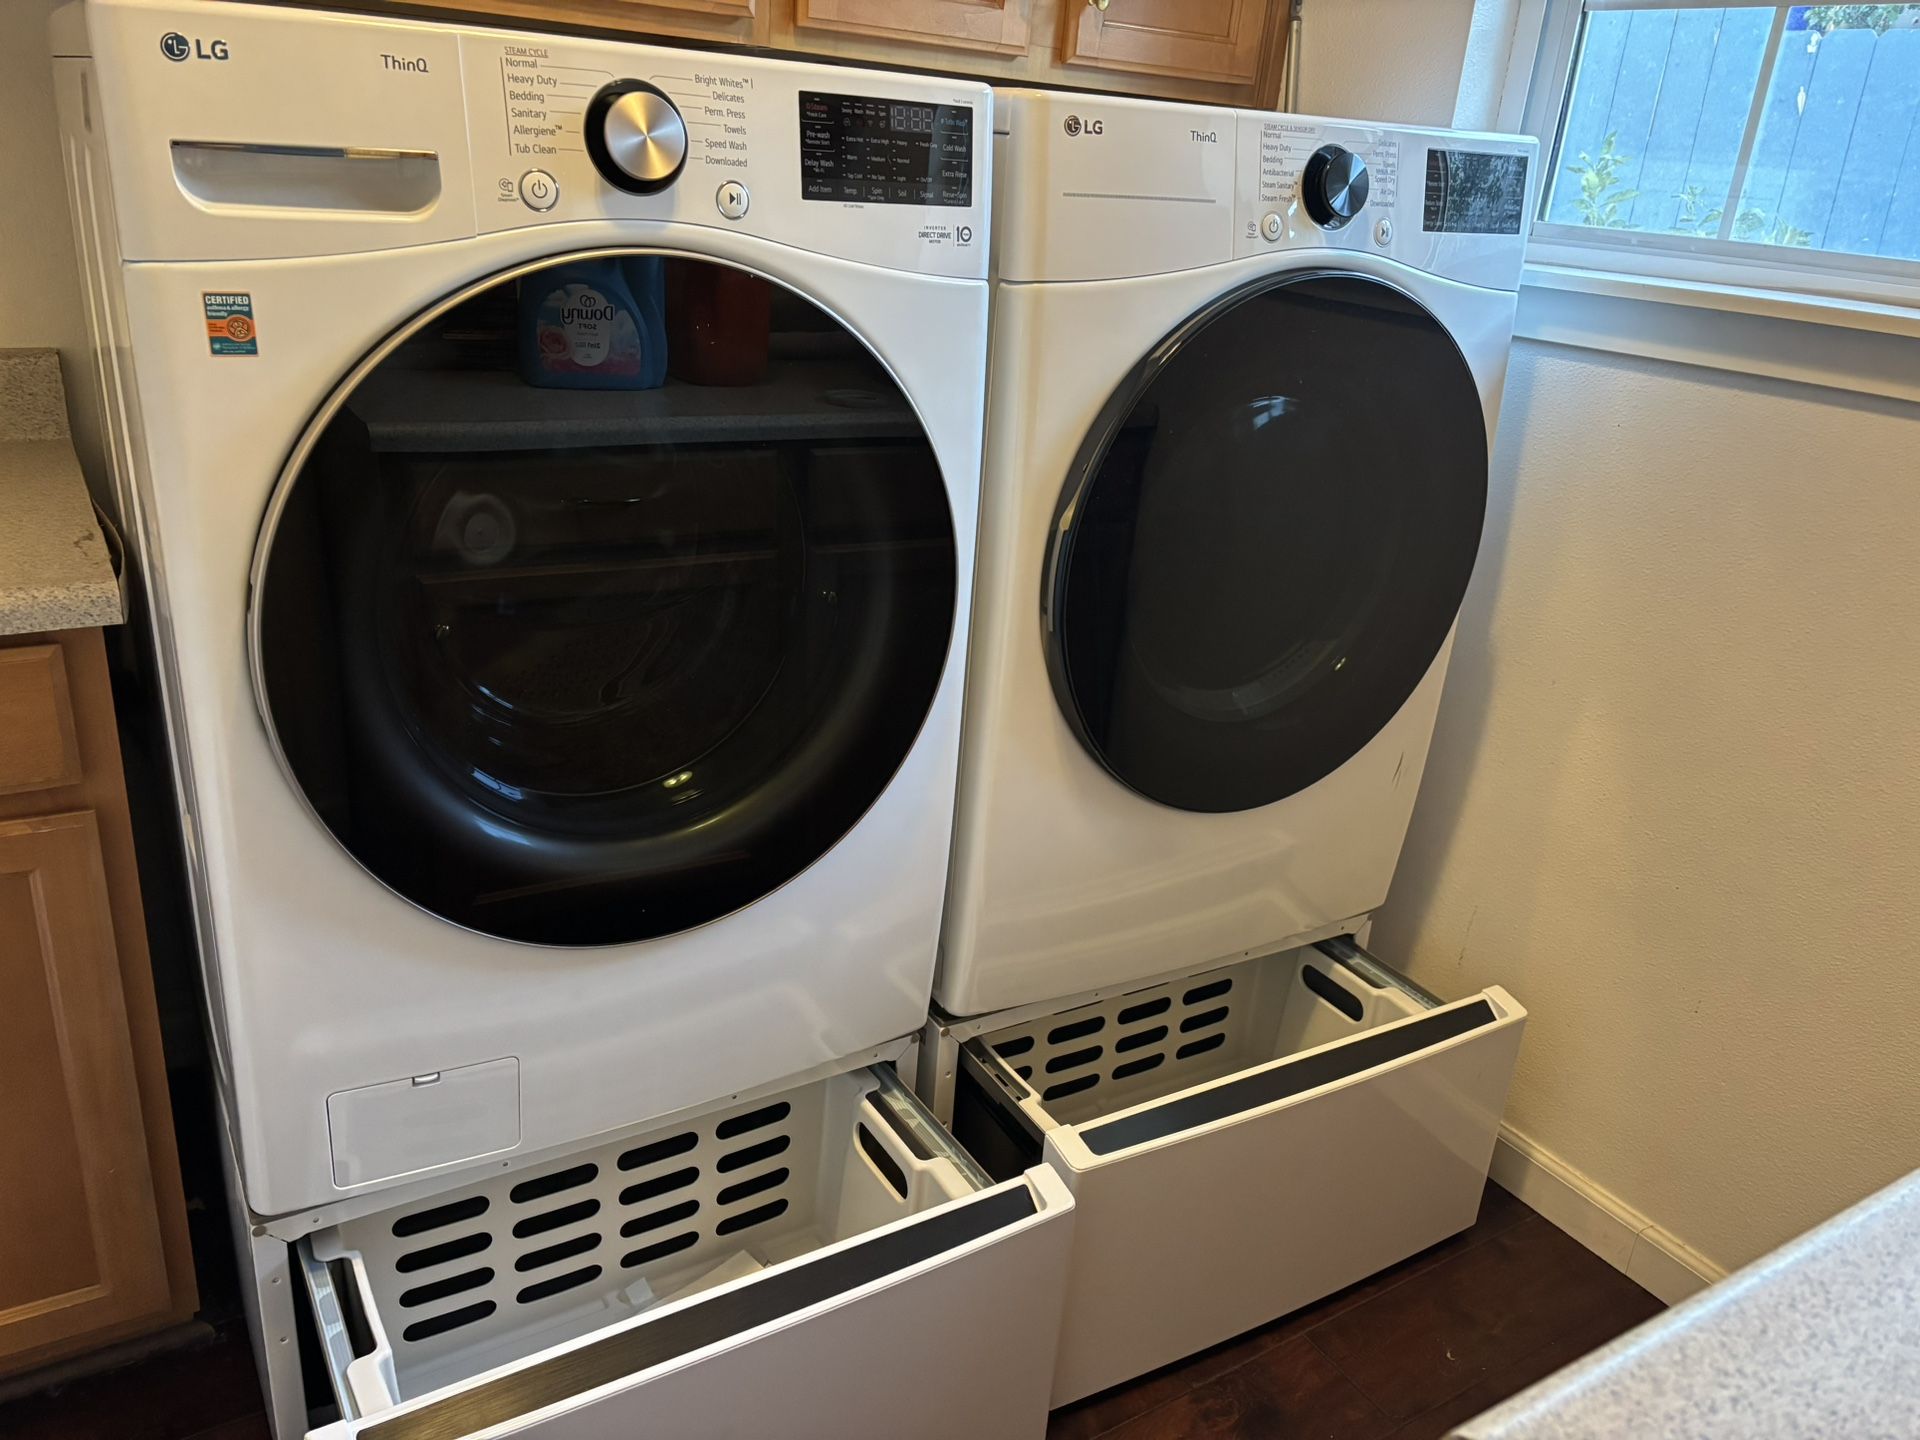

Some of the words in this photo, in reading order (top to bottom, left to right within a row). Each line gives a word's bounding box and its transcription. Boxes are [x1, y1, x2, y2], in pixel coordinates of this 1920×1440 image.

[195, 38, 229, 61] LG
[504, 46, 527, 56] STEAM
[528, 48, 549, 57] CYCLE
[380, 54, 430, 73] ThinQ
[505, 57, 538, 69] Normal
[507, 74, 535, 87] Heavy
[537, 76, 557, 88] Duty
[694, 74, 719, 87] Bright
[509, 90, 545, 103] Bedding
[712, 91, 745, 103] Delicates
[511, 108, 547, 120] Sanitary
[704, 106, 726, 118] Perm.
[726, 108, 746, 119] Press
[723, 124, 747, 135] Towels
[1084, 120, 1103, 135] LG
[806, 131, 830, 140] Pre-wash
[1190, 130, 1218, 144] ThinQ
[1263, 131, 1281, 139] Normal
[514, 144, 531, 154] Tub
[532, 145, 557, 154] Clean
[705, 138, 727, 150] Speed
[728, 140, 748, 150] Wash
[942, 143, 954, 152] Cold
[954, 144, 967, 153] Wash
[1263, 143, 1279, 152] Heavy
[1280, 144, 1292, 152] Duty
[705, 155, 748, 167] Downloaded
[804, 158, 819, 168] Delay
[820, 159, 834, 168] Wash
[1262, 155, 1284, 165] Bedding
[942, 170, 954, 178] Extra
[954, 171, 968, 180] Rinse
[1262, 169, 1295, 177] Antibacterial
[1262, 181, 1276, 189] Steam
[1374, 176, 1387, 184] Speed
[1387, 176, 1395, 185] Dry
[808, 185, 819, 193] Add
[819, 186, 833, 194] Item
[871, 188, 882, 196] Spin
[898, 189, 907, 198] Soil
[1387, 189, 1395, 197] Dry
[919, 191, 934, 200] Signal
[1261, 193, 1278, 202] Steam
[1370, 200, 1394, 208] Downloaded
[918, 231, 936, 239] DIRECT
[956, 225, 972, 243] 10
[205, 295, 249, 305] CERTIFIED
